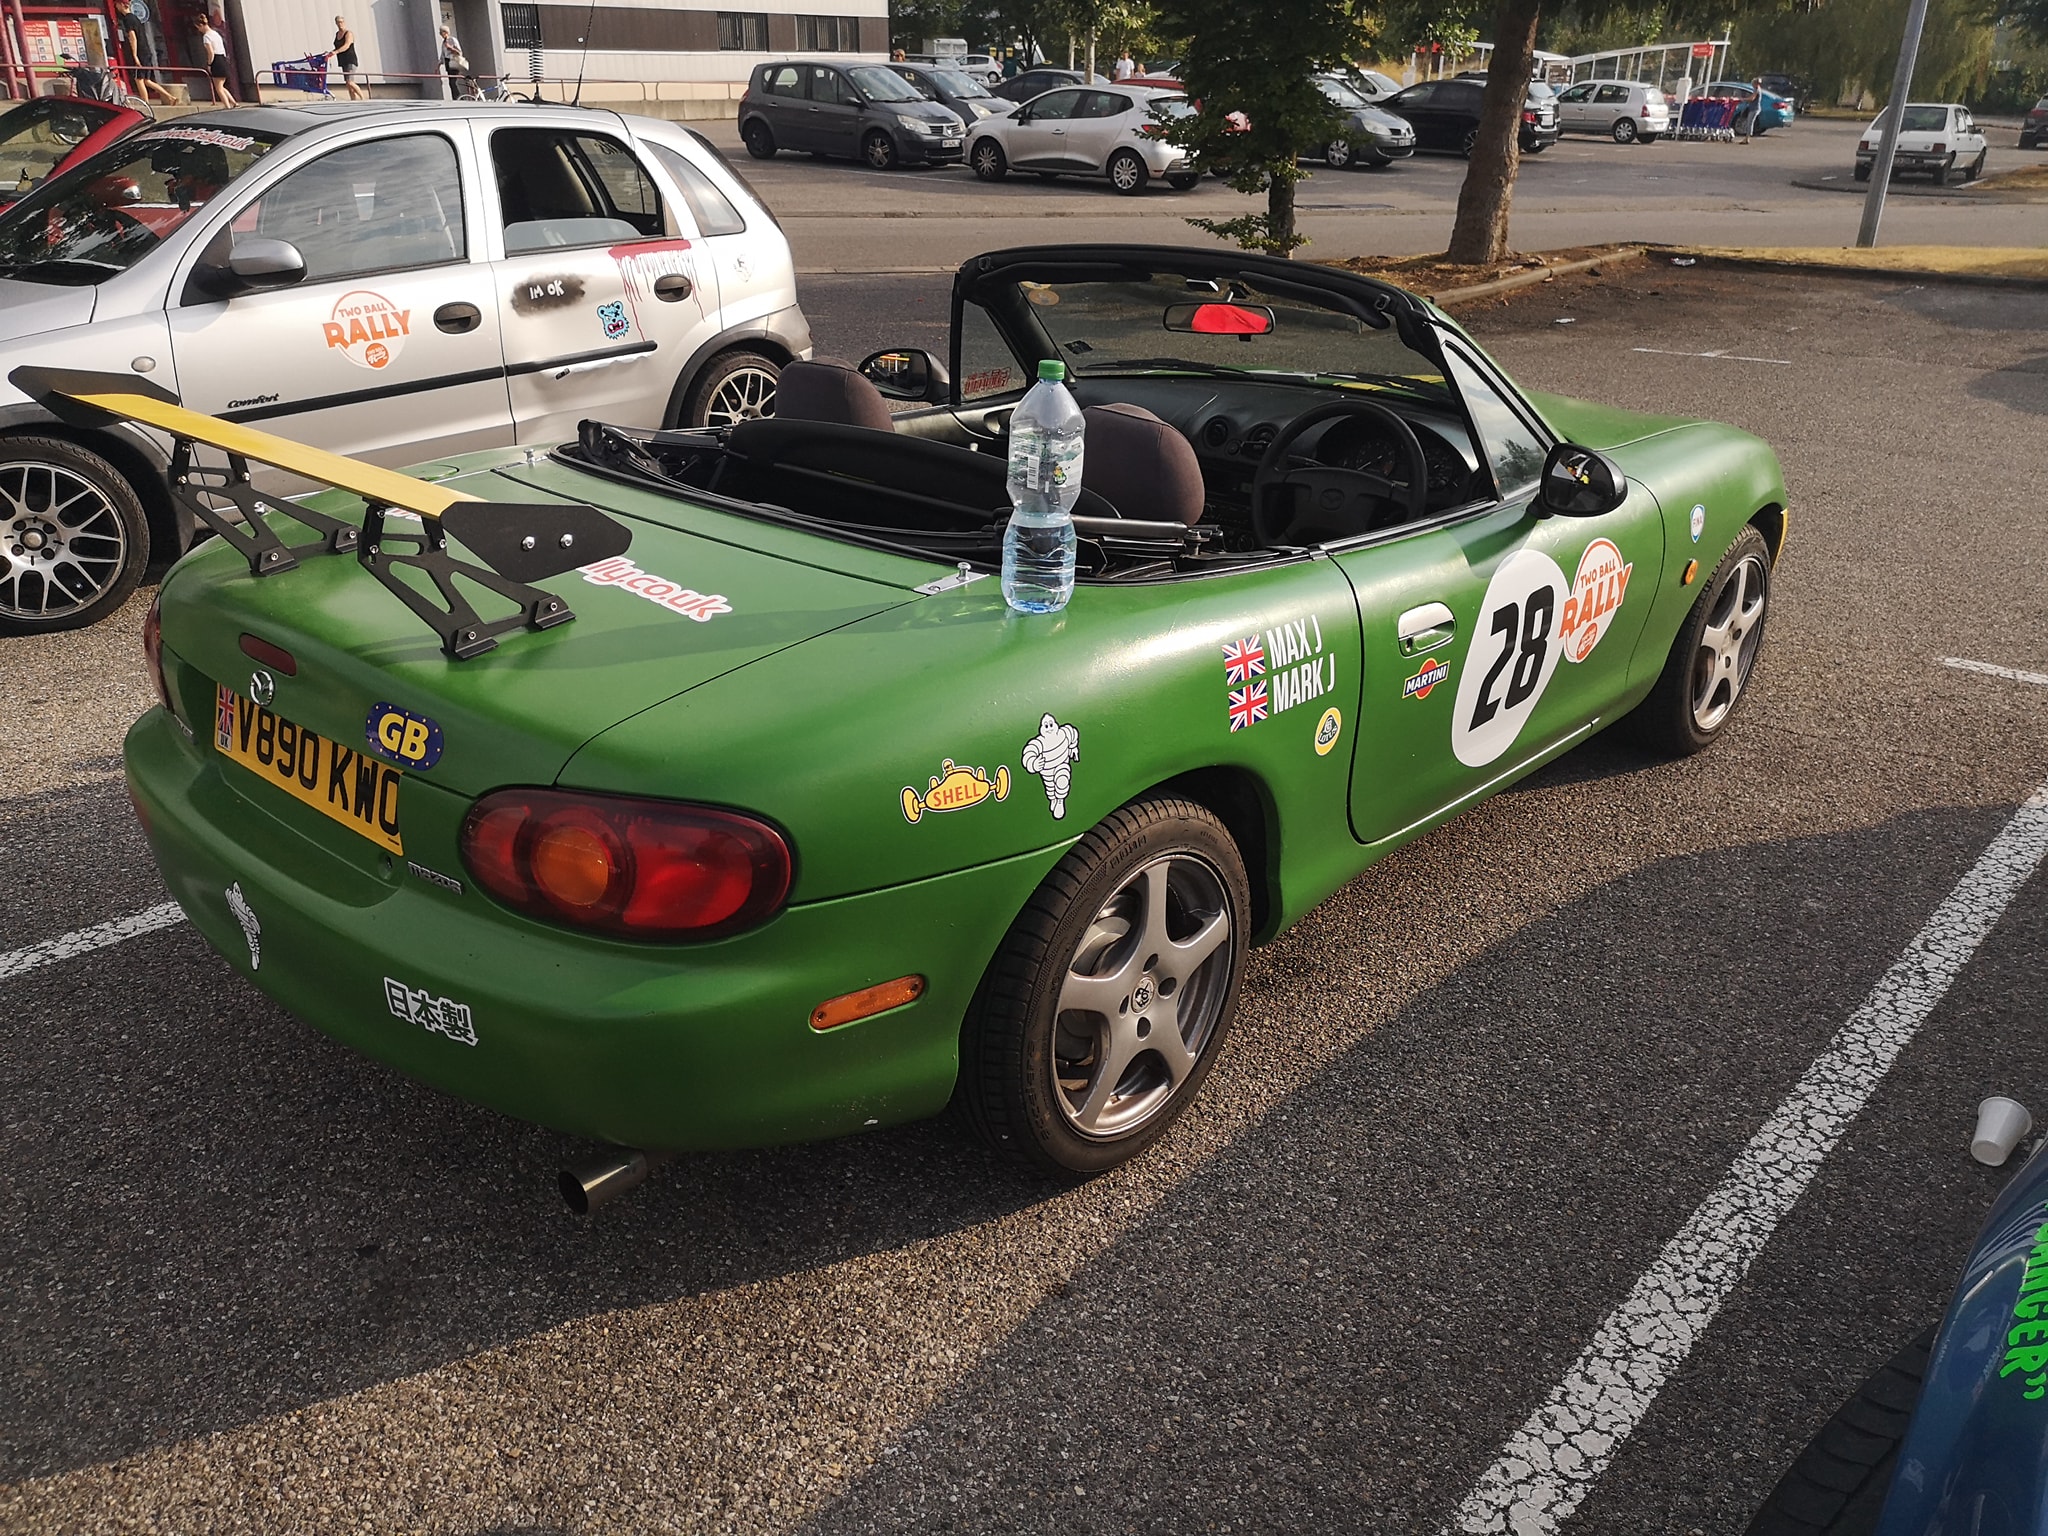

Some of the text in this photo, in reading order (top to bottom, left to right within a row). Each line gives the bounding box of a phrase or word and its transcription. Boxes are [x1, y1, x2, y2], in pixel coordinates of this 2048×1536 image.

[338, 302, 388, 318] TWO BALL
[547, 279, 565, 297] OK
[322, 309, 411, 350] RALLY
[227, 392, 280, 409] Comfort
[1580, 558, 1616, 589] TWO BALL
[1558, 564, 1632, 639] RALLY
[1266, 613, 1323, 670] MAX J
[1468, 584, 1556, 733] 28
[1272, 652, 1335, 715] MARK J
[1405, 664, 1448, 697] MARTINI
[239, 695, 320, 791] V890
[377, 711, 430, 761] GB
[932, 782, 982, 807] SHELL
[385, 979, 476, 1045] 日本製
